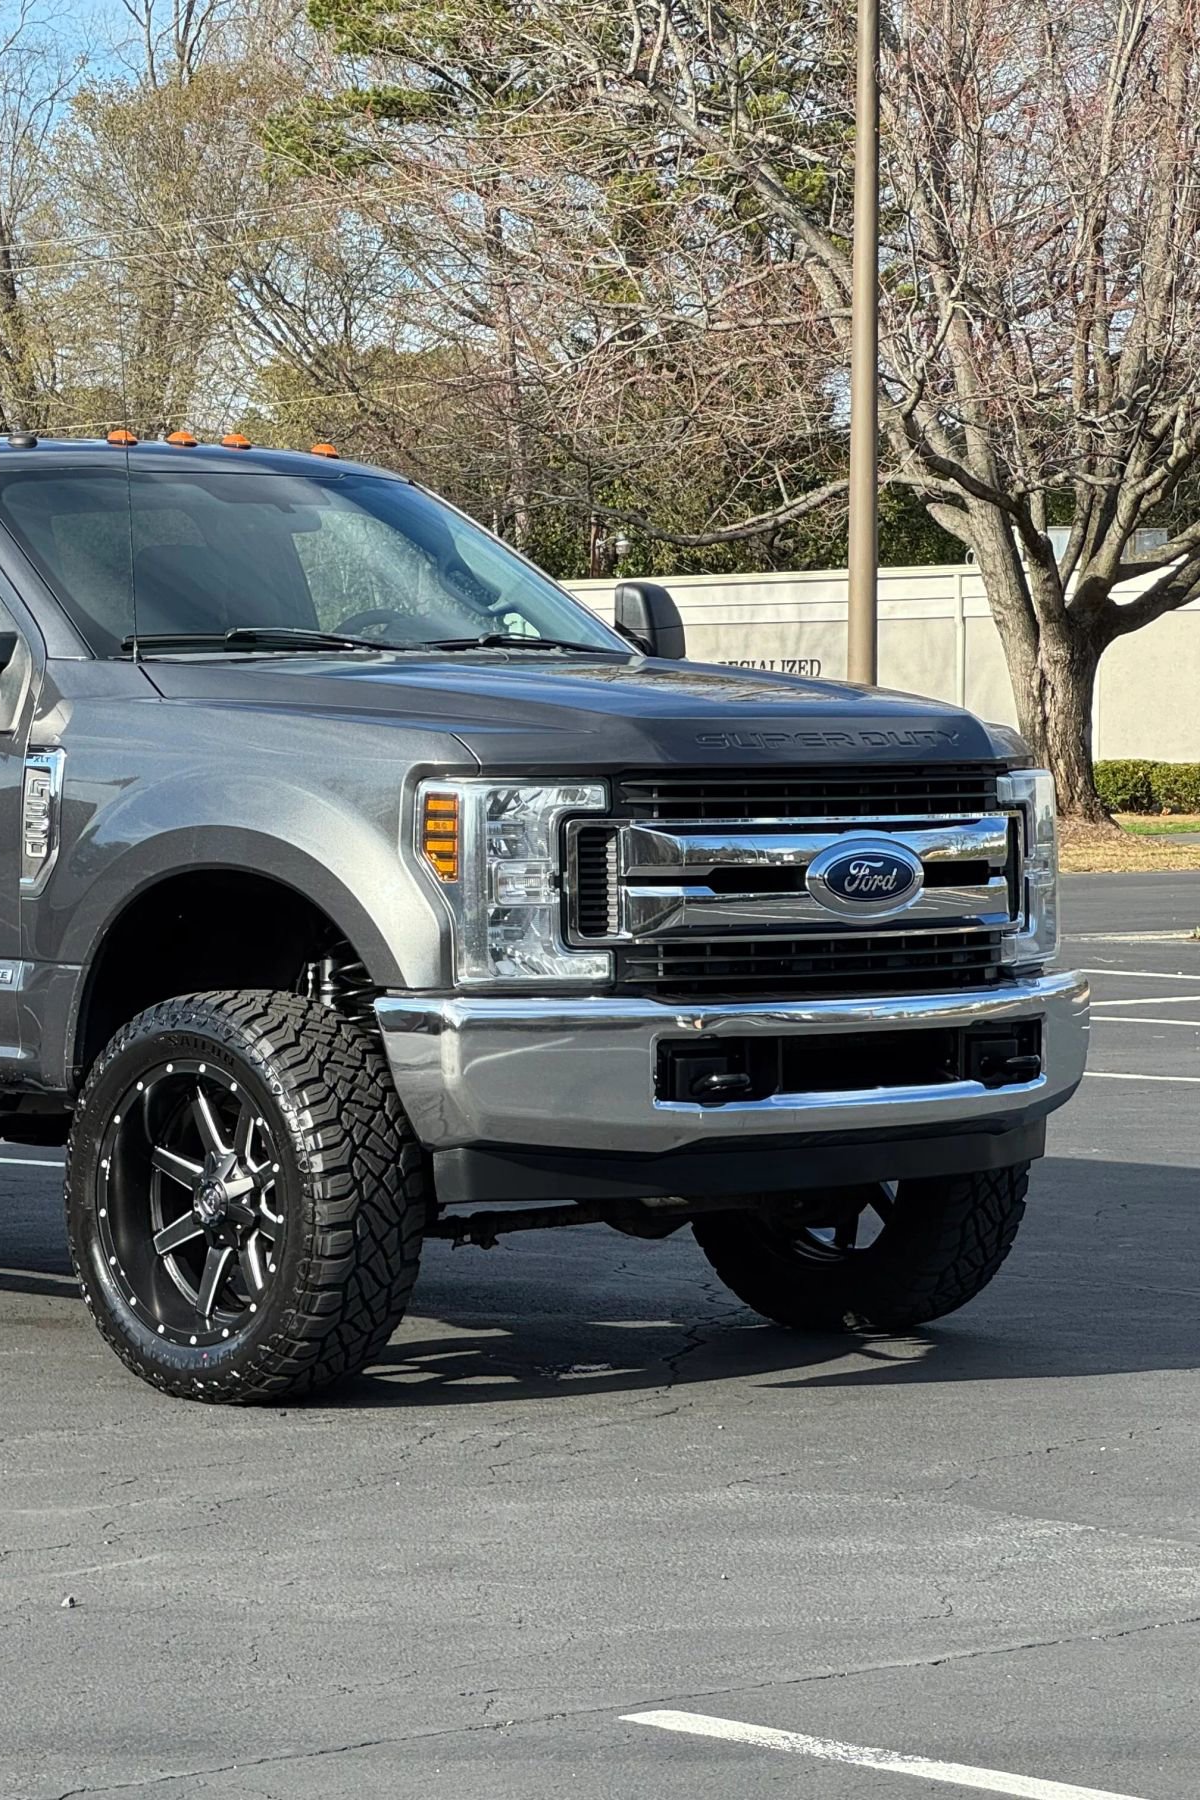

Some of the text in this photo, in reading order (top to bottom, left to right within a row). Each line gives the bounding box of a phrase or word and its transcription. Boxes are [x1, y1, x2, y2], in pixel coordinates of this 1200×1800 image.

[695, 730, 960, 751] SUPER DUTY
[32, 755, 51, 763] XLT
[843, 860, 898, 892] Ford
